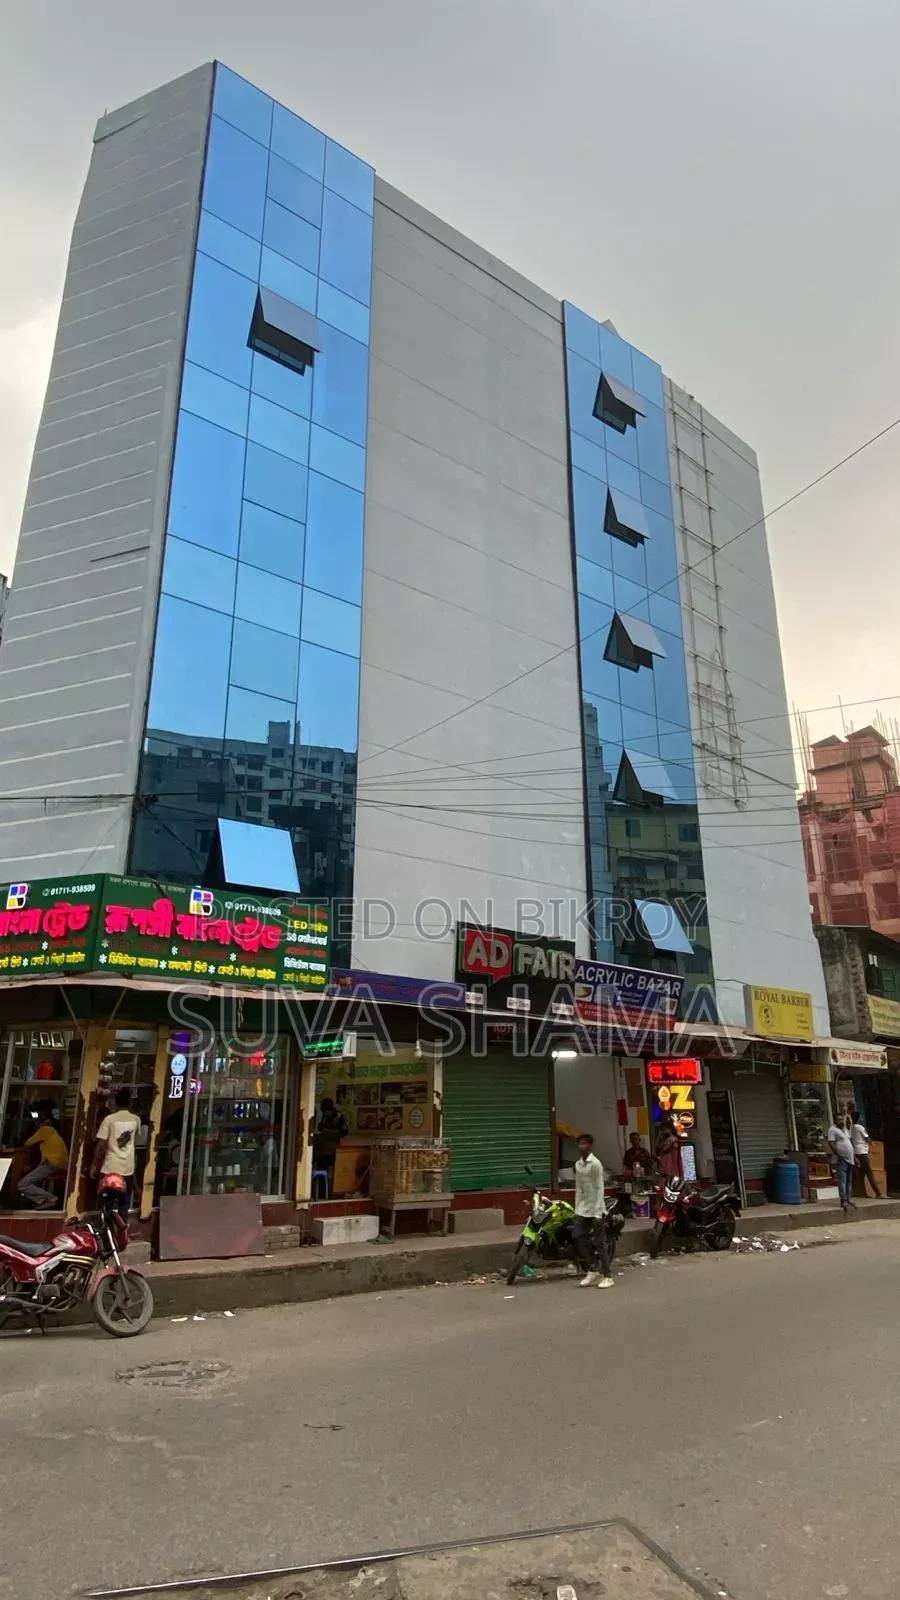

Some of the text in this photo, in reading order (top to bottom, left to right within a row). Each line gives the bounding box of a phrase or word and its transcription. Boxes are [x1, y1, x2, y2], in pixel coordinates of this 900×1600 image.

[43, 901, 91, 938] ট্রেড
[287, 919, 308, 931] LED
[466, 935, 576, 982] AD FAIR
[575, 964, 682, 996] ACRYLIC BAZAR
[754, 990, 810, 1009] ROYAL BARBER
